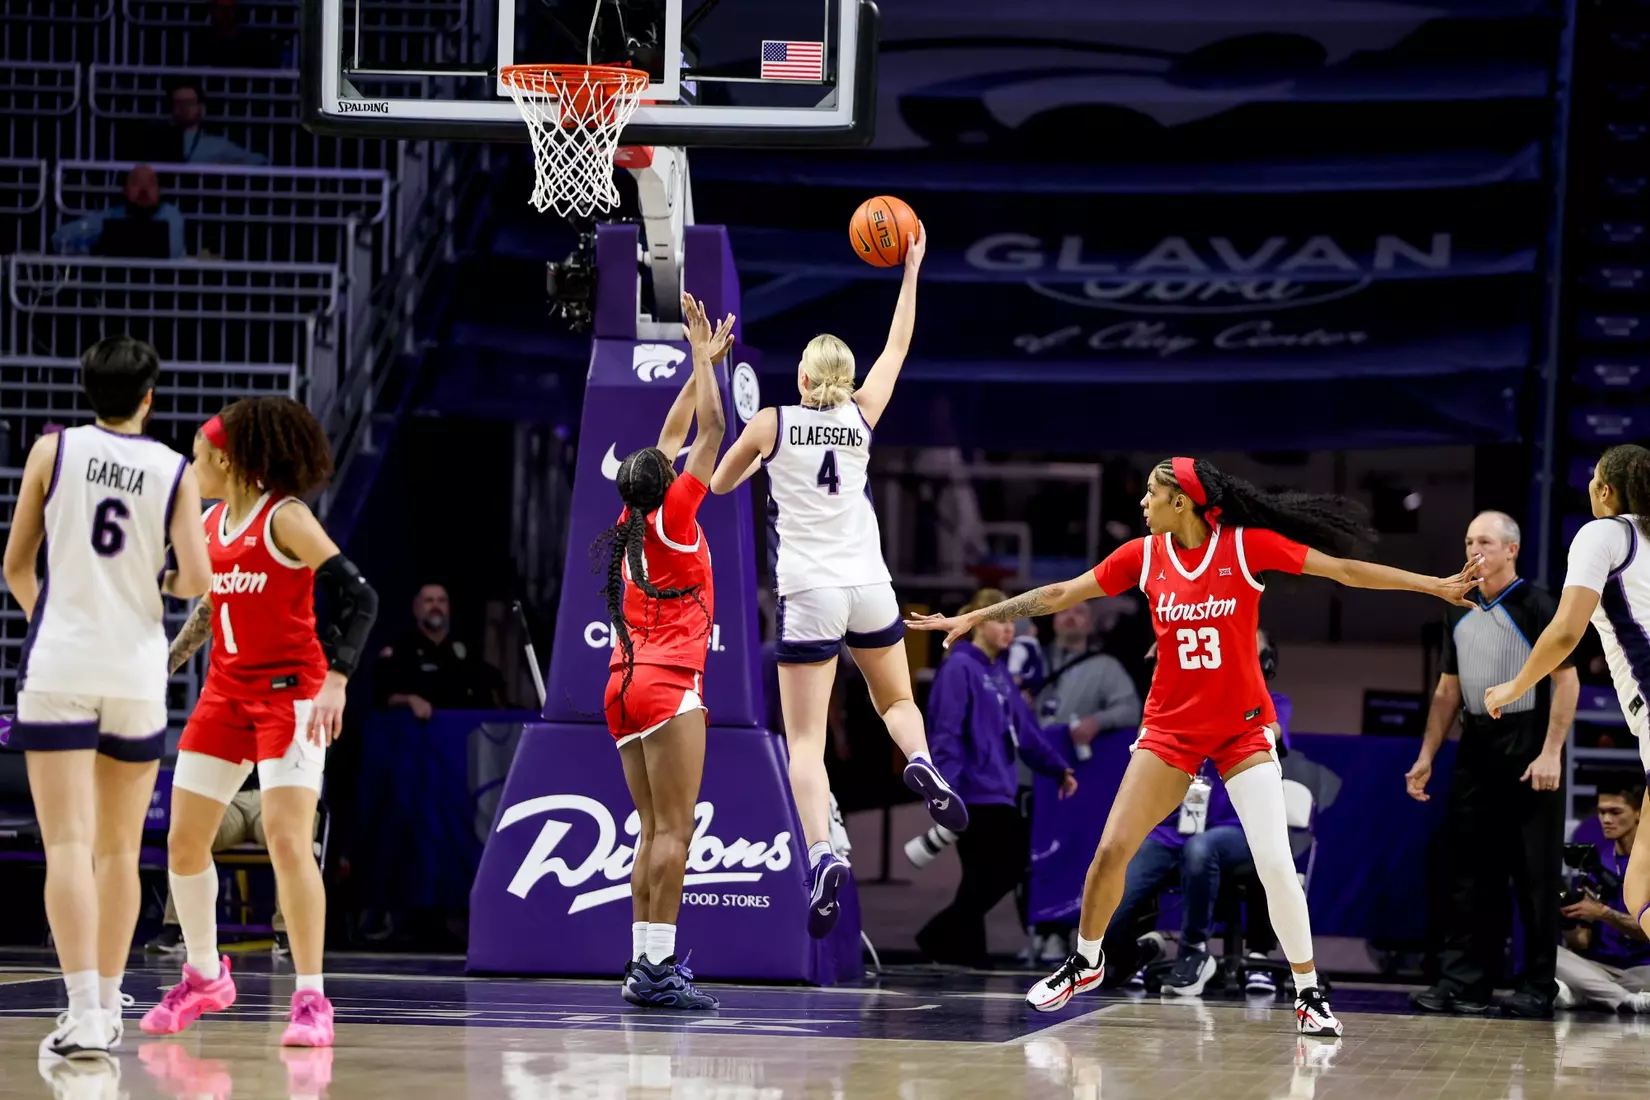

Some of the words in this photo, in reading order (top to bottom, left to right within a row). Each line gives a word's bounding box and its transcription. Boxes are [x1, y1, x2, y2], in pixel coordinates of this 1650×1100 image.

[337, 101, 389, 113] SPALDING
[872, 209, 892, 249] ELITE
[964, 231, 1453, 273] GLAVAN
[790, 425, 863, 447] CLAESSENS
[86, 457, 145, 496] GARCIA
[817, 448, 841, 496] 4
[91, 497, 131, 558] 6
[208, 563, 268, 596] uston
[1156, 591, 1237, 622] Houston
[220, 602, 239, 654] 1
[1176, 627, 1222, 670] 23
[496, 794, 792, 900] Dilons
[682, 892, 719, 906] FOOD
[722, 894, 771, 908] STORES
